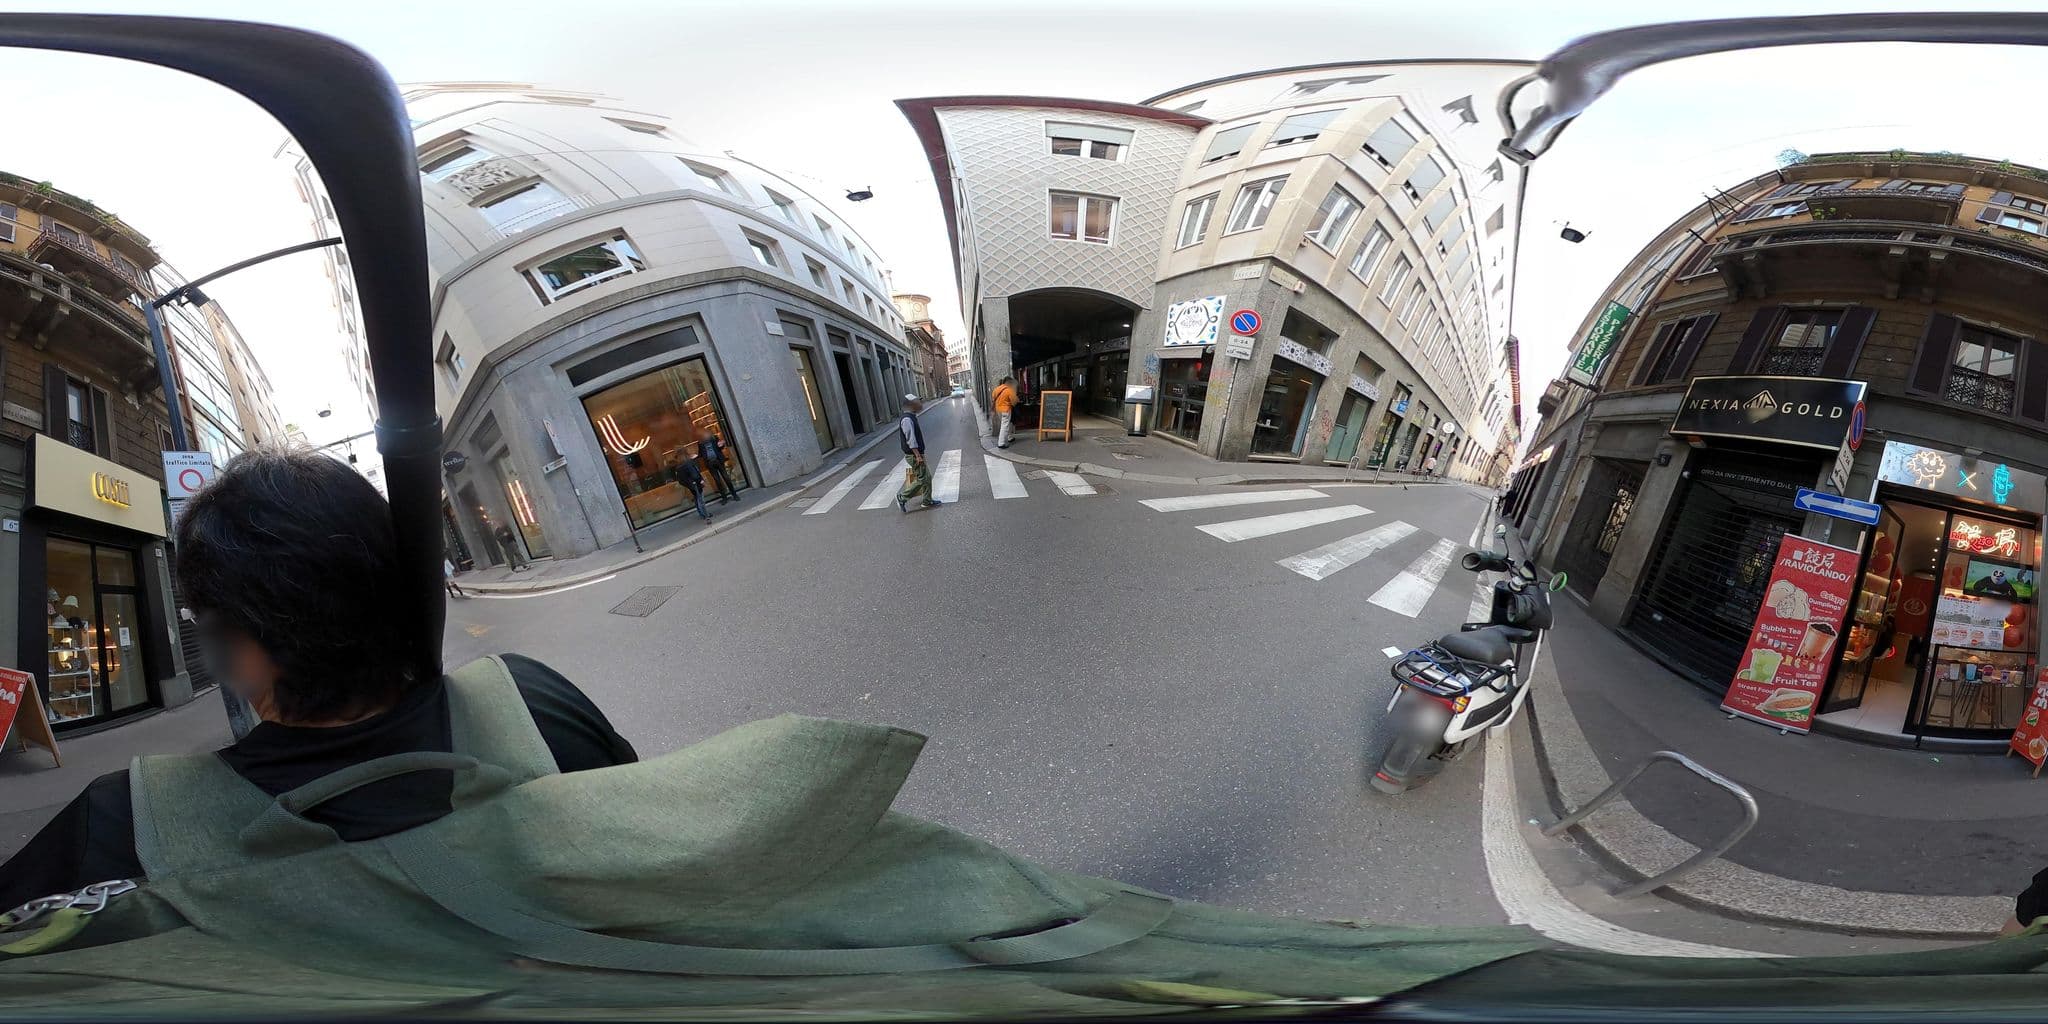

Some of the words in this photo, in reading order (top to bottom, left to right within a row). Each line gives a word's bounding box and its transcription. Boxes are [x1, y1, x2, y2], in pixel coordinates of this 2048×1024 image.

[1576, 303, 1618, 370] RISTORANTE
[1585, 318, 1621, 374] PIZZERIA
[1689, 399, 1739, 411] NEXIA
[1781, 402, 1843, 419] GOLD
[1808, 597, 1841, 612] Dumplings
[1761, 623, 1787, 635] Bubble
[1789, 626, 1802, 635] Tea
[1737, 683, 1757, 692] Street
[1775, 676, 1798, 686] Fruit
[1801, 679, 1818, 688] Tea
